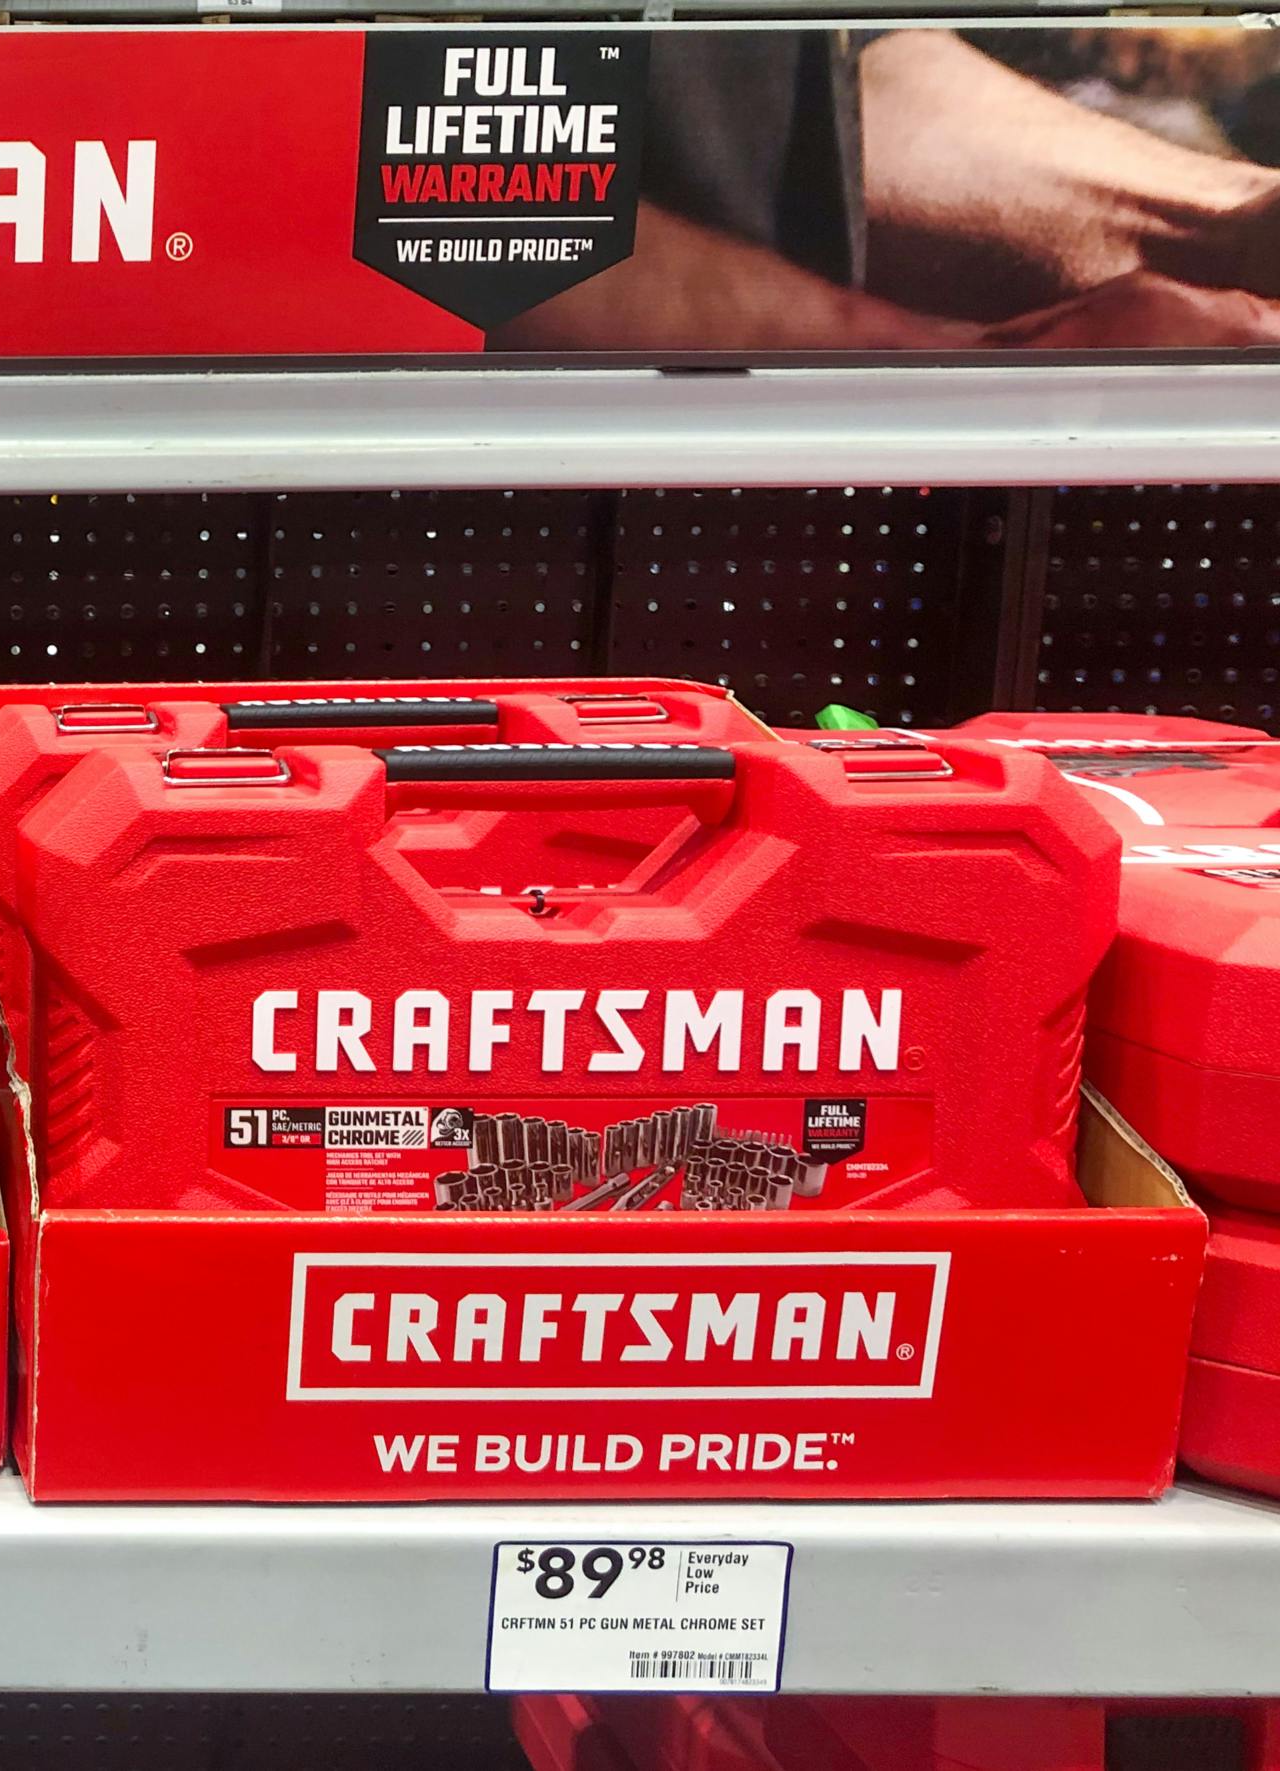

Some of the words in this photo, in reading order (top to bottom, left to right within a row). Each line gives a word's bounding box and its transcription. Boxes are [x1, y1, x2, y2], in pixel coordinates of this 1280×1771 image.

[443, 47, 567, 96] FULL
[385, 105, 618, 154] LIFETIME
[380, 163, 617, 203] WARRANTY
[396, 239, 433, 262] WE
[438, 239, 503, 262] BUILD
[272, 1109, 290, 1120] PC.
[820, 1105, 849, 1116] FULL
[328, 1111, 424, 1126] GUNMETAL
[808, 1116, 861, 1128] LIFETIME
[230, 1109, 267, 1145] 51
[272, 1122, 322, 1132] SAE/METRIC
[453, 1127, 470, 1141] 3X
[808, 1128, 860, 1137] WARRANTY
[328, 1129, 400, 1146] CHROME
[374, 1434, 460, 1474] WE
[474, 1434, 642, 1473] BUILD
[688, 1551, 749, 1566] Everyday
[686, 1566, 713, 1579] Low
[685, 1581, 720, 1593] Price
[501, 1617, 556, 1630] CRFTMN
[559, 1617, 574, 1630] 51
[579, 1617, 596, 1630] PC
[600, 1617, 629, 1630] GUN
[632, 1618, 675, 1631] METAL
[680, 1618, 738, 1631] CHROME
[741, 1618, 766, 1631] SET
[629, 1650, 650, 1659] Item
[652, 1651, 658, 1659] #
[661, 1650, 696, 1660] 997802
[697, 1652, 717, 1660] Model
